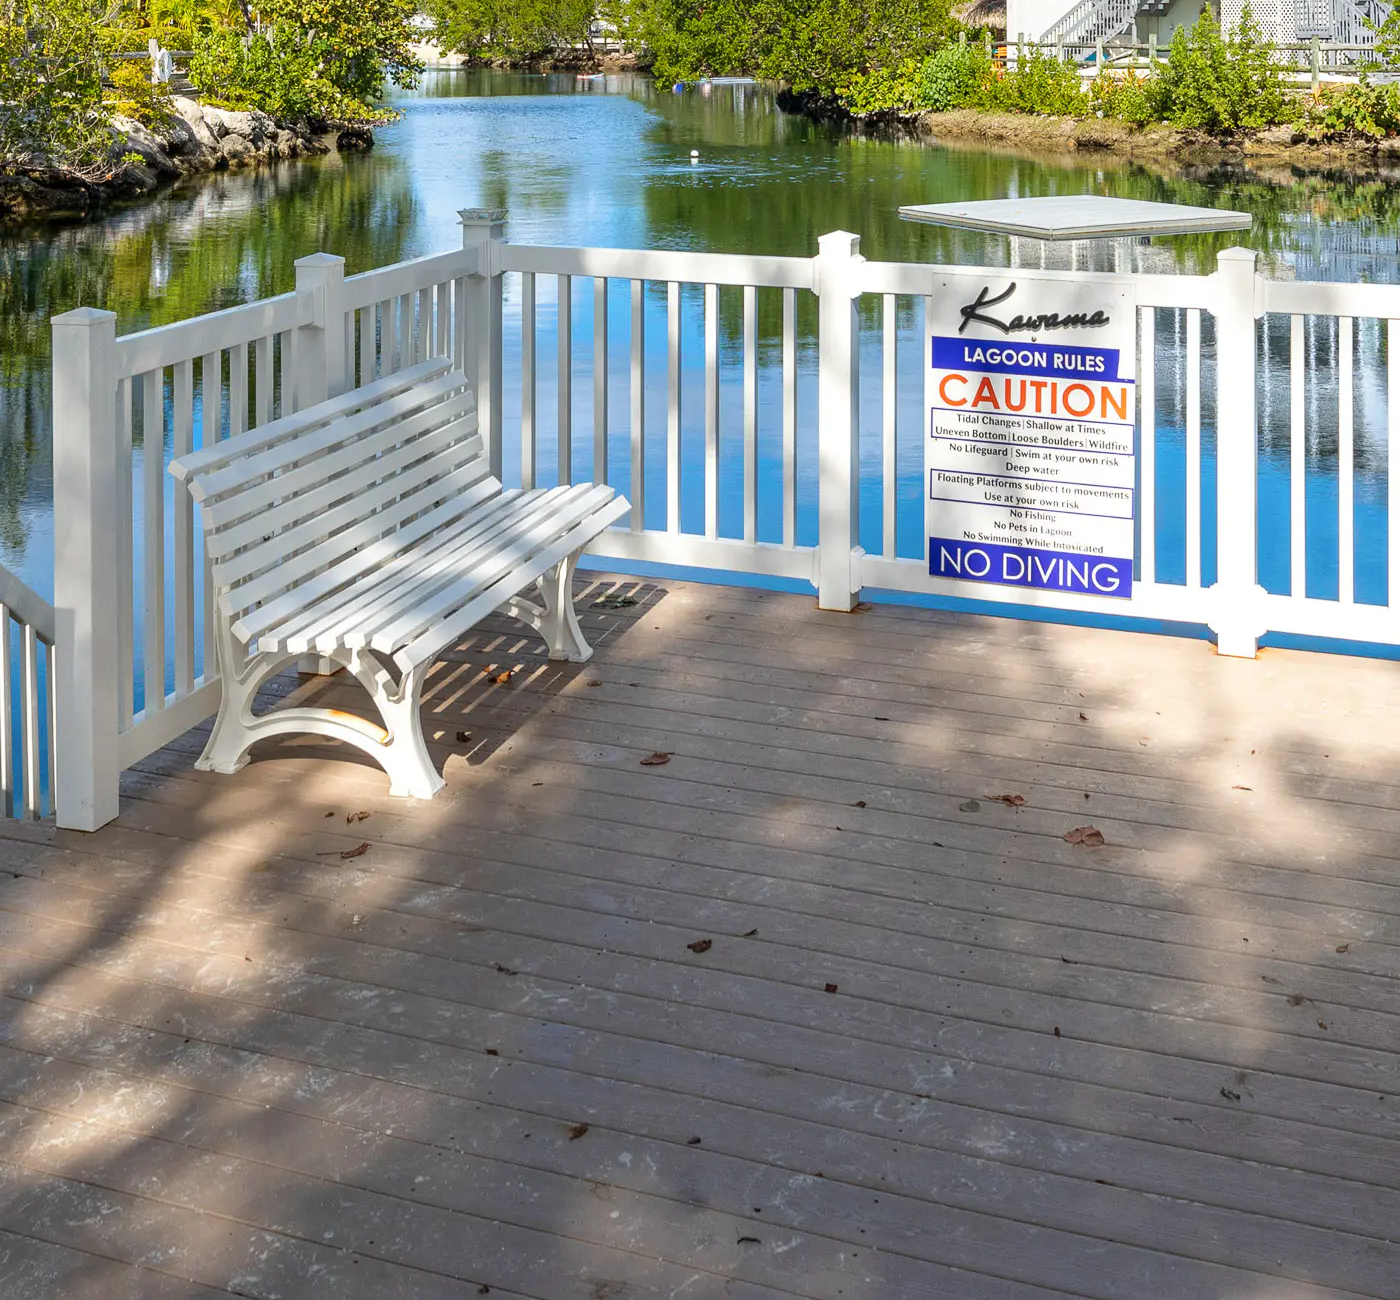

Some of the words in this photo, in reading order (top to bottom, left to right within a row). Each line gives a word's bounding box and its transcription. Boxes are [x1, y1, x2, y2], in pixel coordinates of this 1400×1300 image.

[964, 346, 1047, 368] LAGOON
[1053, 352, 1106, 373] RULES
[938, 373, 1127, 420] CAUTION
[957, 413, 979, 424] Tidal
[981, 415, 1021, 429] Changes
[1026, 419, 1063, 431] Shallow
[1065, 424, 1075, 433] at
[1077, 424, 1106, 435] Times
[935, 426, 970, 437] Uneven
[972, 429, 1007, 441] Bottom
[1012, 432, 1040, 444] Loose
[1041, 435, 1084, 448] Boulders
[949, 443, 963, 452] No
[965, 444, 1008, 457] Lifeguard
[1015, 448, 1041, 459] Swim
[1042, 452, 1052, 461] at
[1054, 454, 1077, 463] your
[1078, 456, 1099, 465] own
[1101, 457, 1119, 467] risk
[1005, 461, 1031, 475] Deep
[1032, 466, 1060, 475] water
[937, 472, 975, 487] Floating
[976, 476, 1023, 490] Platforms
[1024, 481, 1059, 494] subject
[1061, 487, 1072, 495] to
[1074, 488, 1130, 500] movements
[984, 491, 1002, 502] Use
[1004, 495, 1014, 503] at
[1015, 496, 1037, 506] your
[1039, 499, 1059, 508] own
[1061, 499, 1080, 510] risk
[1009, 508, 1023, 518] No
[1025, 510, 1057, 523] Fishing
[993, 520, 1007, 530] No
[1008, 522, 1028, 533] Pets
[1029, 524, 1038, 533] in
[1040, 525, 1073, 537] Lagoon
[963, 530, 976, 540] No
[978, 532, 1023, 547] Swimming
[1025, 536, 1051, 548] While
[1053, 540, 1104, 554] Intoxicated
[940, 545, 991, 577] NO
[1002, 552, 1121, 592] DIVING
